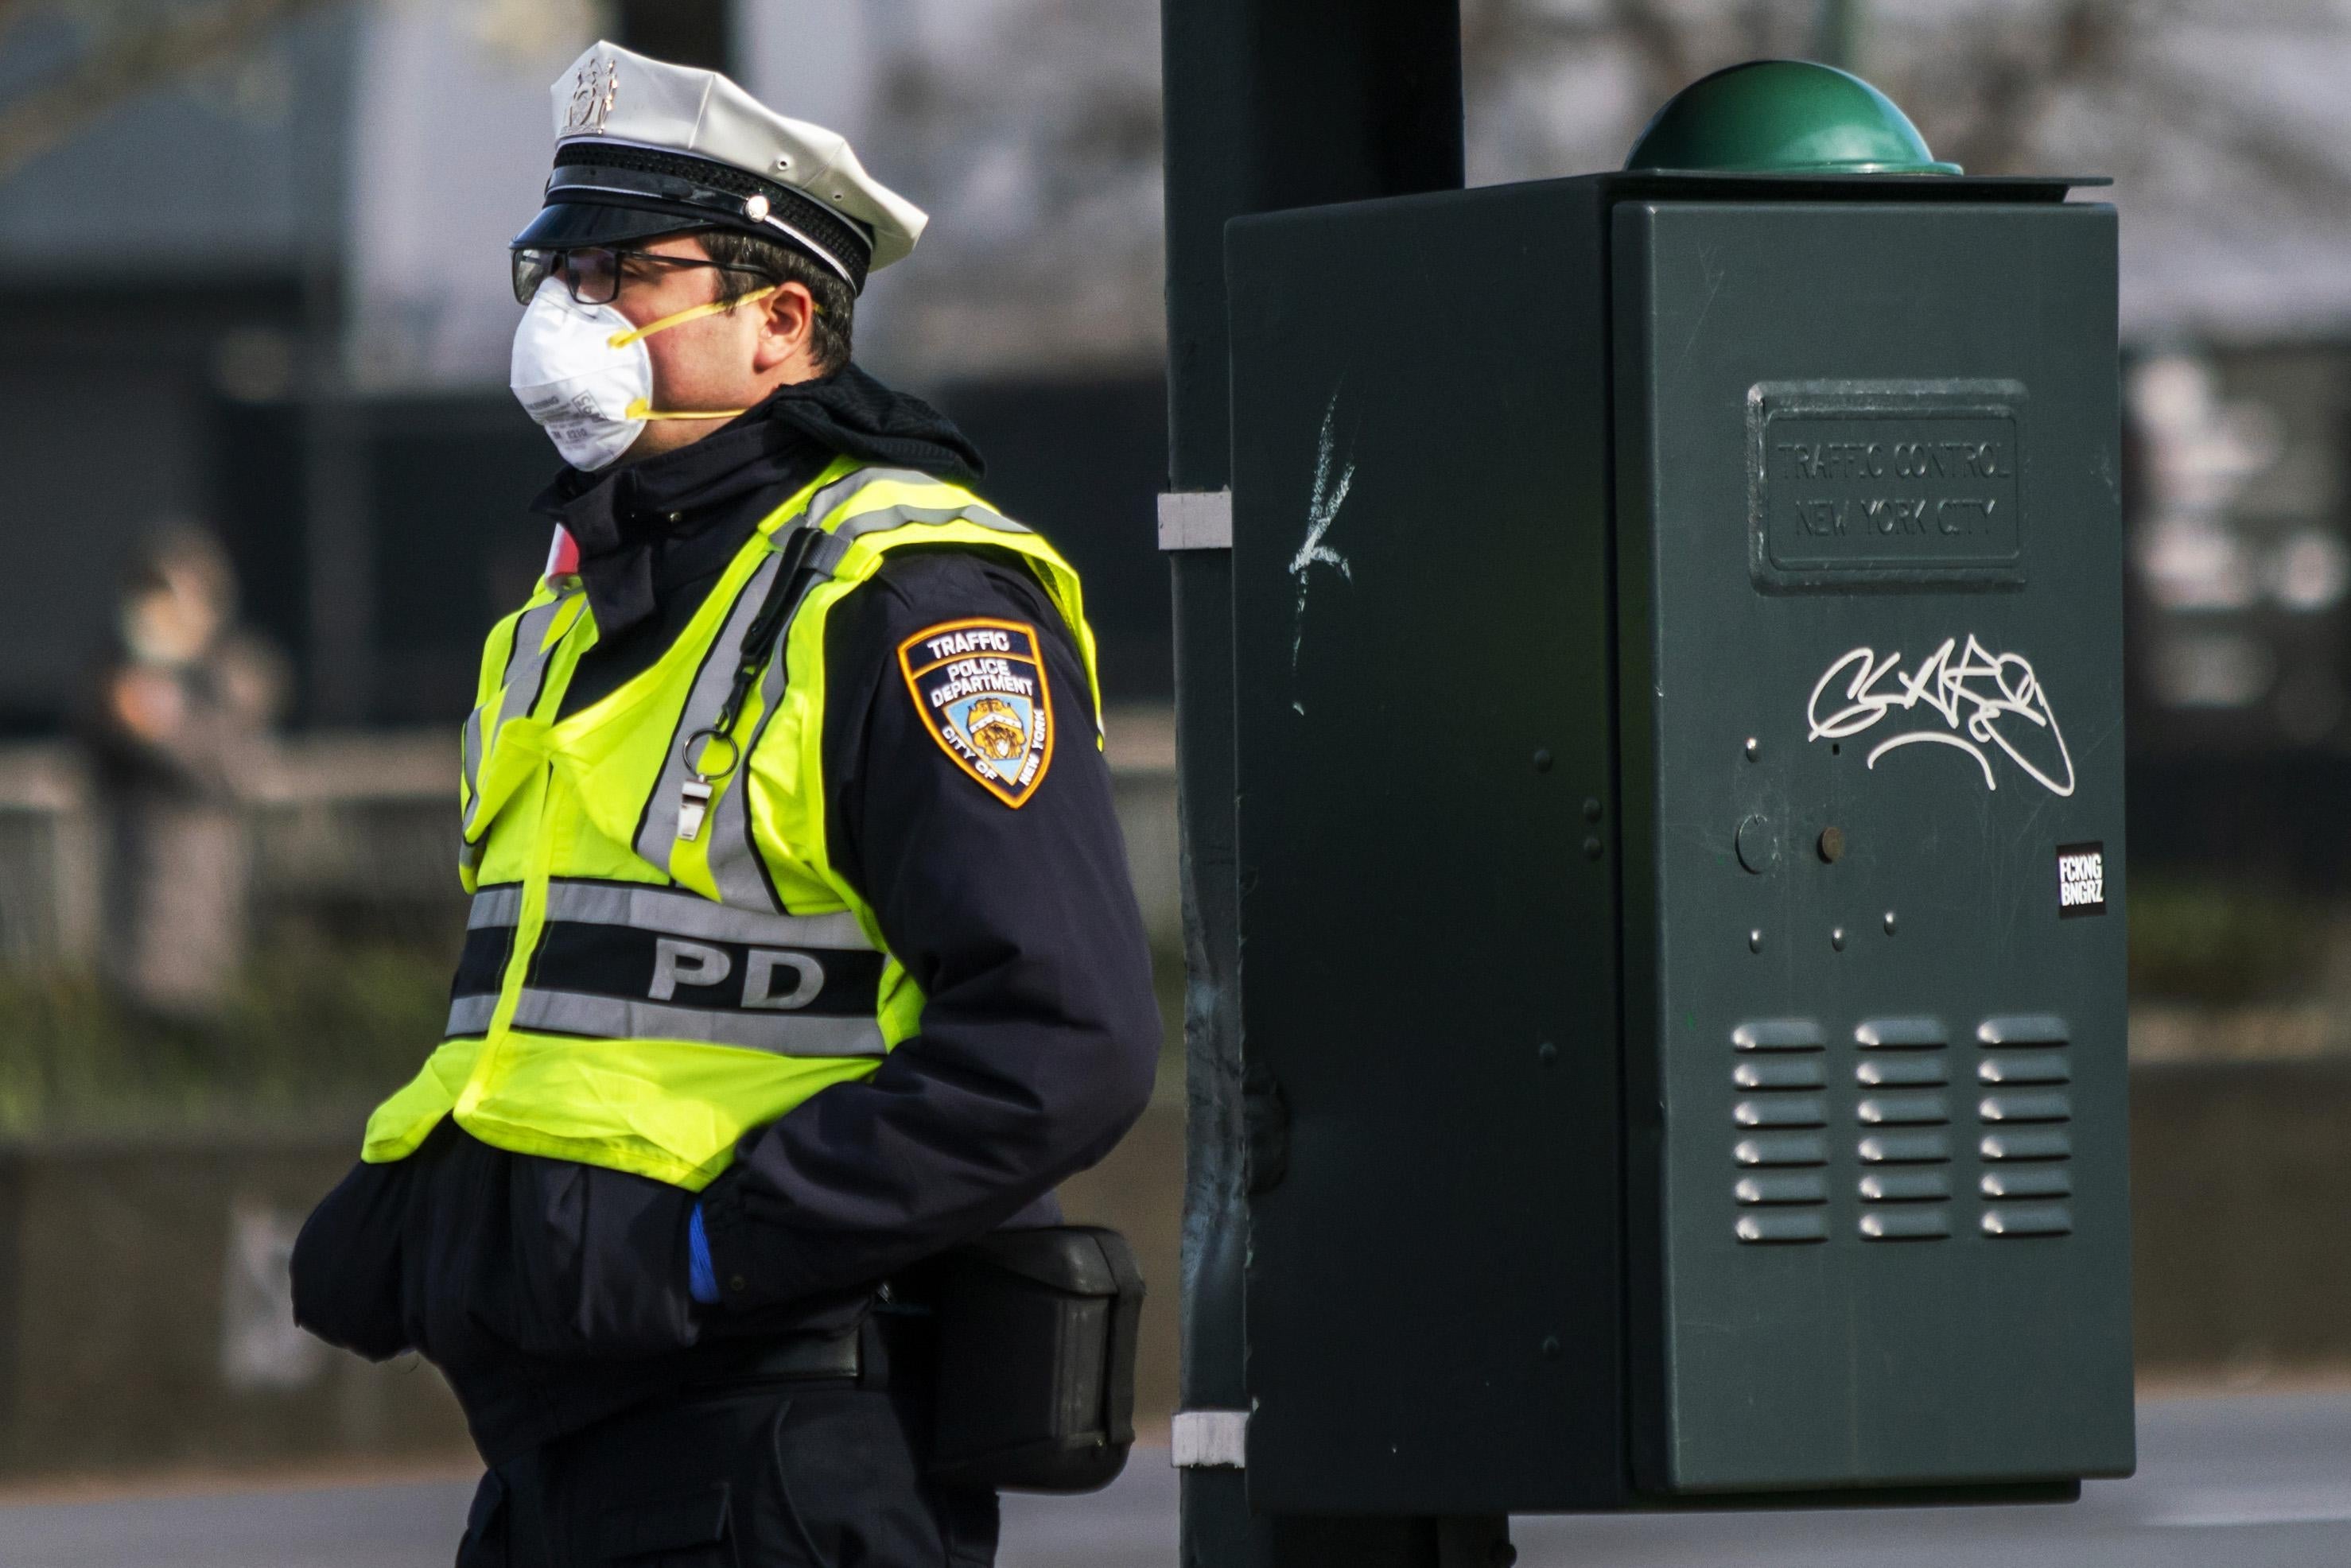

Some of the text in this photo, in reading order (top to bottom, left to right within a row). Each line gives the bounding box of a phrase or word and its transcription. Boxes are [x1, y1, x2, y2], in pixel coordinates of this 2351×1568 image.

[1778, 441, 2010, 479] TRAFFIC CONTROL
[1795, 499, 1996, 536] NEW YORK CITY
[927, 631, 1010, 659] TRAFFIC
[946, 658, 1011, 682] POLICE
[930, 675, 1033, 708] DEPARTMENT
[942, 708, 1045, 786] CITY OF NEW YORK
[2058, 852, 2103, 883] FCKNG
[2061, 879, 2104, 906] BNGRZ
[647, 936, 825, 1010] PD
